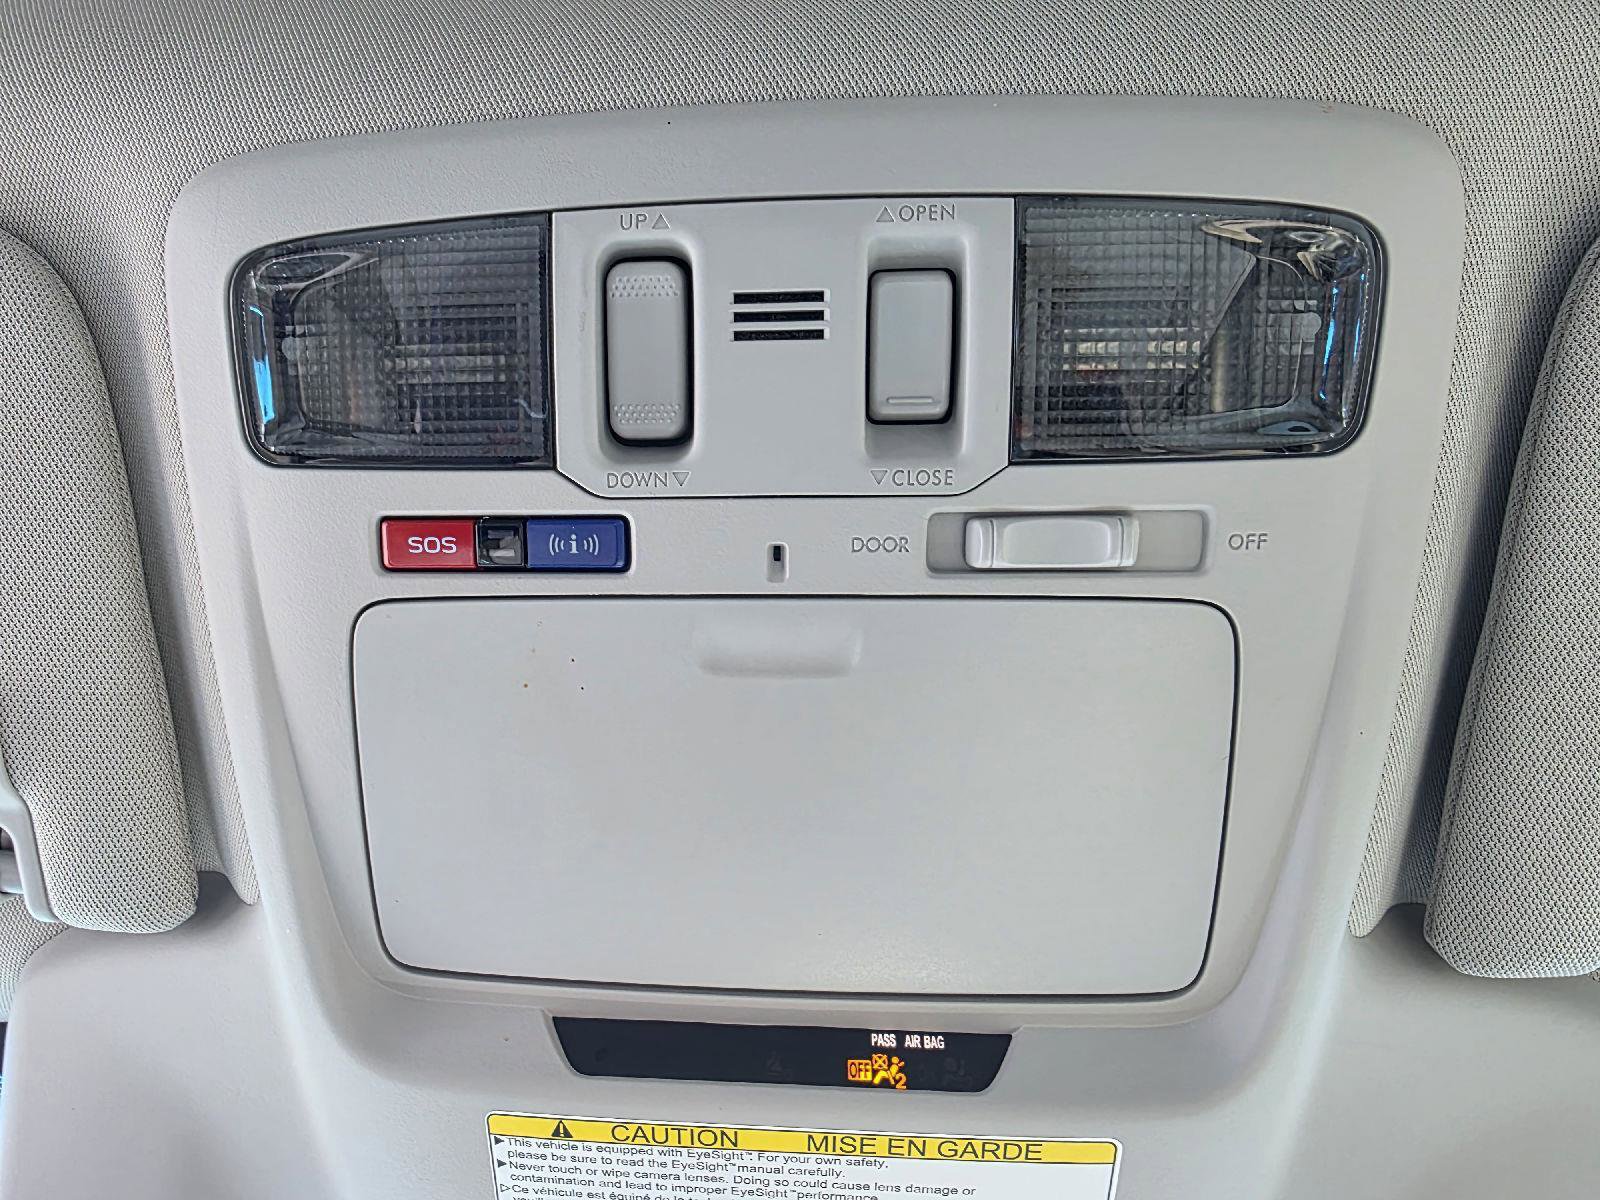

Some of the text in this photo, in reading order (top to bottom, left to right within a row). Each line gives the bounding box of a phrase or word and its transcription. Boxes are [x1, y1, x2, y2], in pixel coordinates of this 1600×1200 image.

[620, 214, 648, 230] UP
[898, 204, 955, 222] OPEN
[606, 472, 668, 489] DOWN
[891, 470, 954, 486] CLOSE
[408, 536, 457, 554] SOS
[851, 536, 910, 553] DOOR
[1228, 533, 1268, 550] OFF
[871, 1033, 945, 1049] PASS AIR BAG
[848, 1061, 872, 1080] OFF
[507, 1137, 532, 1148] This
[536, 1140, 578, 1151] vehicle
[582, 1142, 592, 1152] is
[596, 1145, 653, 1157] equipped
[657, 1147, 682, 1158] with
[757, 1152, 780, 1162] For
[783, 1155, 809, 1165] your
[815, 1157, 842, 1165] own
[611, 1124, 1043, 1161] CAUTION MISE EN GARDE
[507, 1149, 548, 1160] please
[551, 1152, 567, 1161] be
[570, 1155, 597, 1164] sure
[600, 1156, 612, 1165] to
[616, 1158, 644, 1167] read
[648, 1158, 668, 1168] the
[737, 1164, 784, 1175] manual
[787, 1167, 846, 1179] carefully.
[508, 1160, 976, 1197] Never touch or wipe camera lenses. Doing so could cause lens damage or
[510, 1173, 595, 1187] contamination
[599, 1179, 622, 1189] and
[625, 1181, 652, 1191] lead
[655, 1183, 668, 1191] to
[671, 1183, 727, 1196] improper
[511, 1184, 529, 1194] Ce
[532, 1187, 583, 1197] véhicule
[586, 1191, 606, 1199] est
